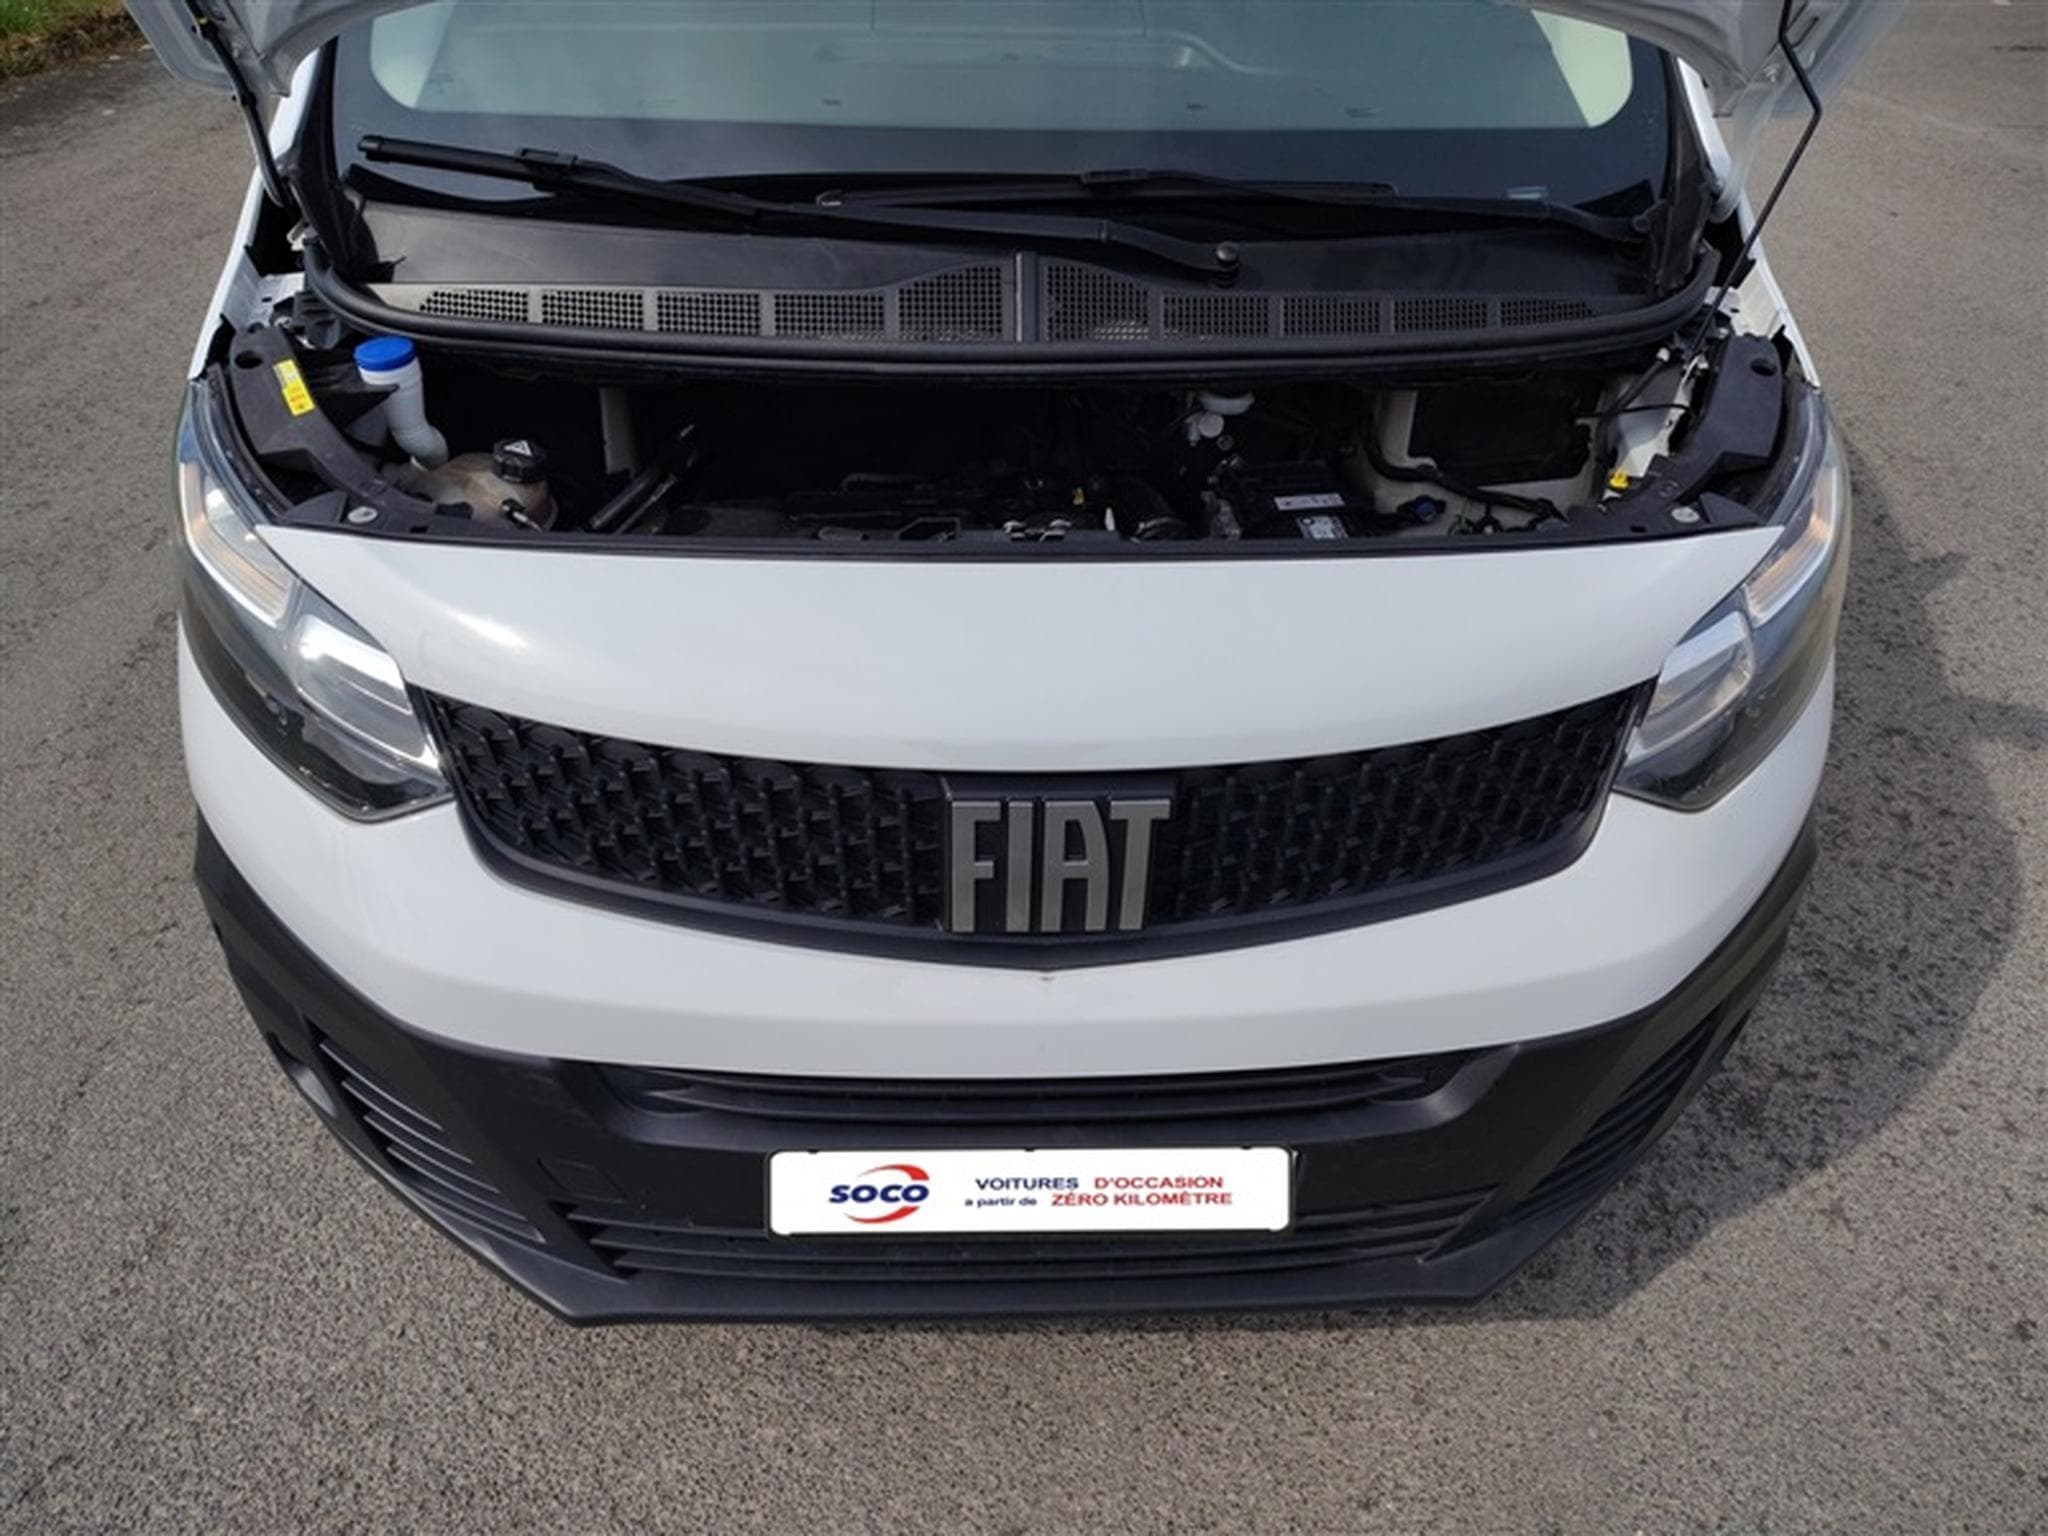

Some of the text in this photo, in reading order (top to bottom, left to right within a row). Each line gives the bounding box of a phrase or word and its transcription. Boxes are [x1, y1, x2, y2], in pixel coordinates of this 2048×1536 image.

[951, 799, 1170, 932] FIAT
[975, 1176, 1223, 1190] VOITURES D'OCCASION
[829, 1184, 929, 1203] SOCO
[977, 1197, 1016, 1209] partir
[1018, 1197, 1037, 1206] de
[1051, 1192, 1109, 1206] ZÉRO
